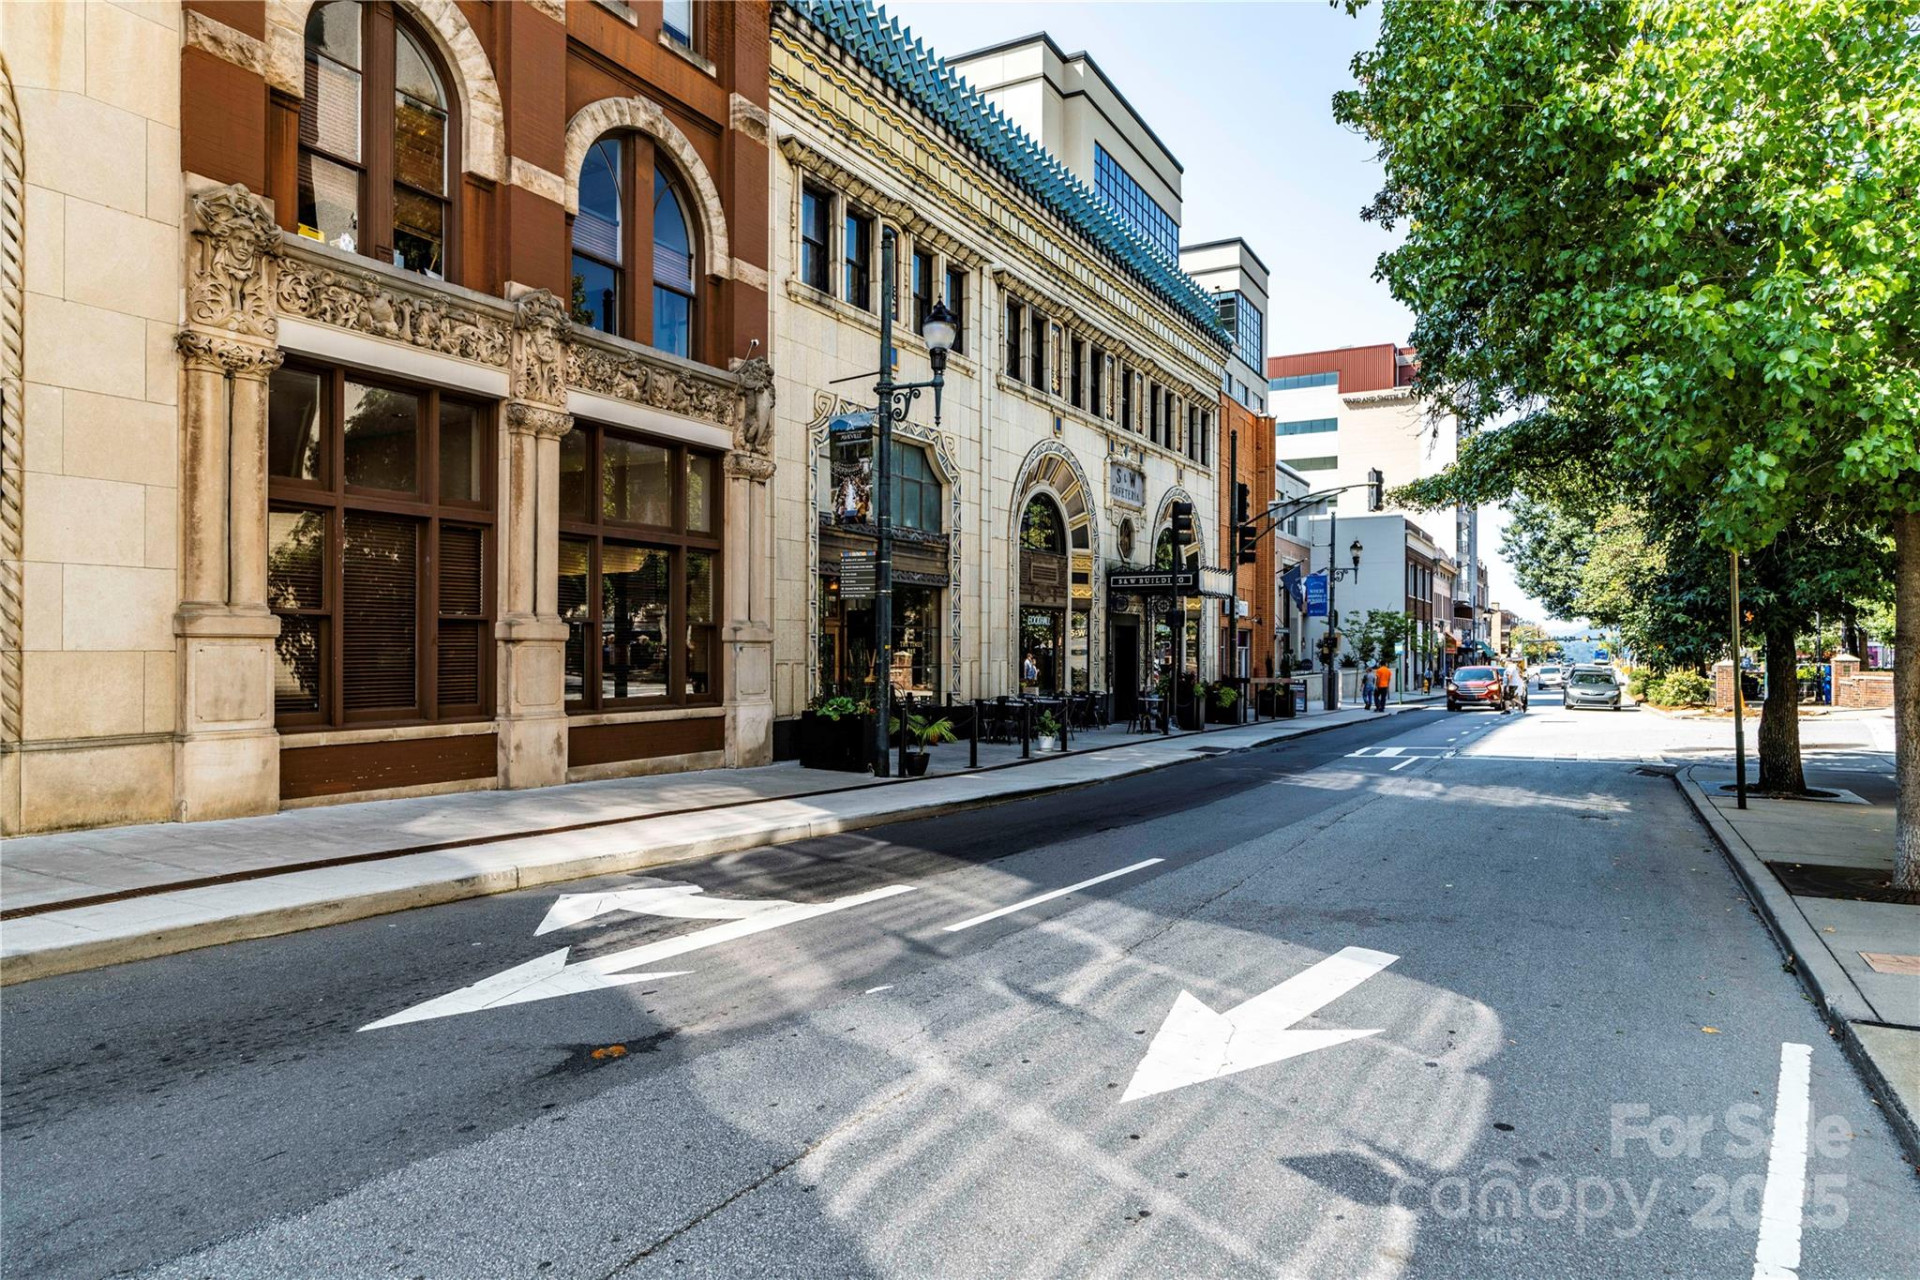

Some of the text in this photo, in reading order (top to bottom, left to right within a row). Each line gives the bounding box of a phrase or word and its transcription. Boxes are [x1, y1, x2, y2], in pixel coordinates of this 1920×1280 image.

[1116, 468, 1121, 483] S
[1129, 472, 1136, 488] W
[1111, 485, 1140, 501] CAFETERIA
[1138, 576, 1184, 584] BUILDIG
